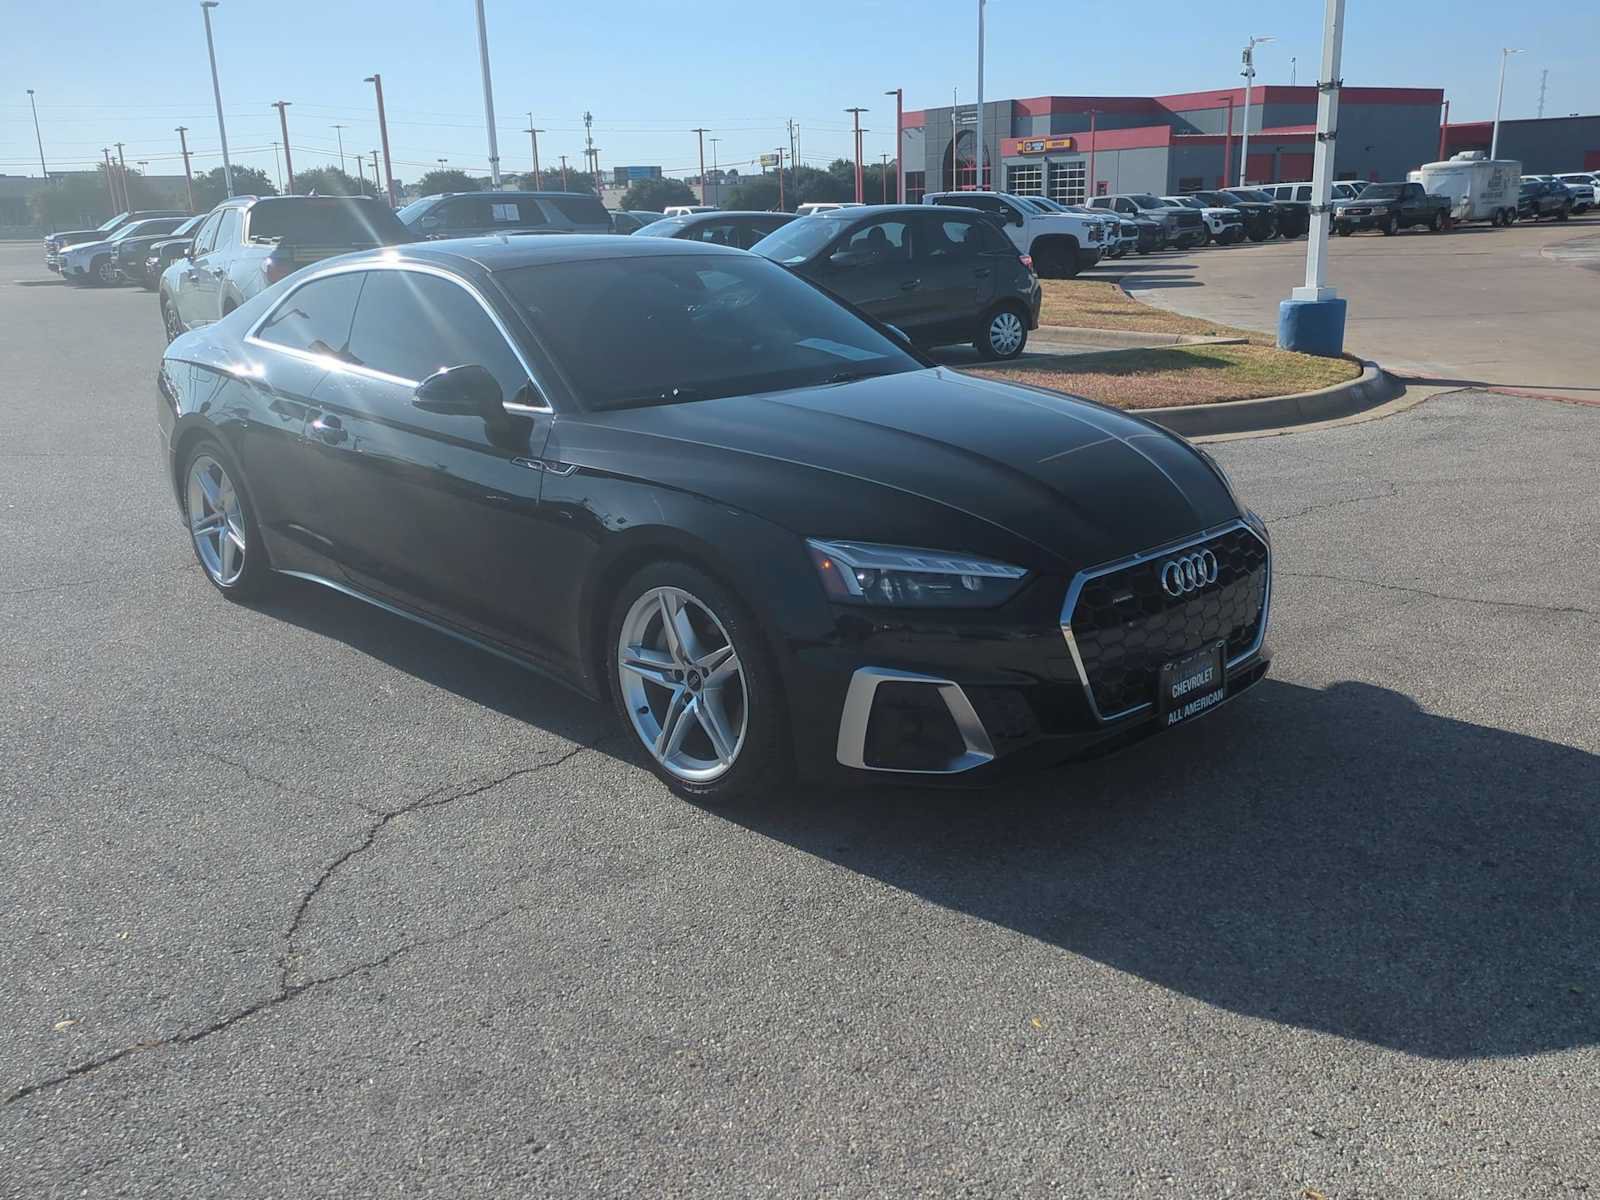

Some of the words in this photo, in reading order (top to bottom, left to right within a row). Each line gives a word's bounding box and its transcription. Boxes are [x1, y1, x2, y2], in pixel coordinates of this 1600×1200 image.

[1172, 667, 1213, 698] CHEVROLET
[1168, 709, 1184, 726] ALL
[1184, 688, 1224, 717] AMERICAN
